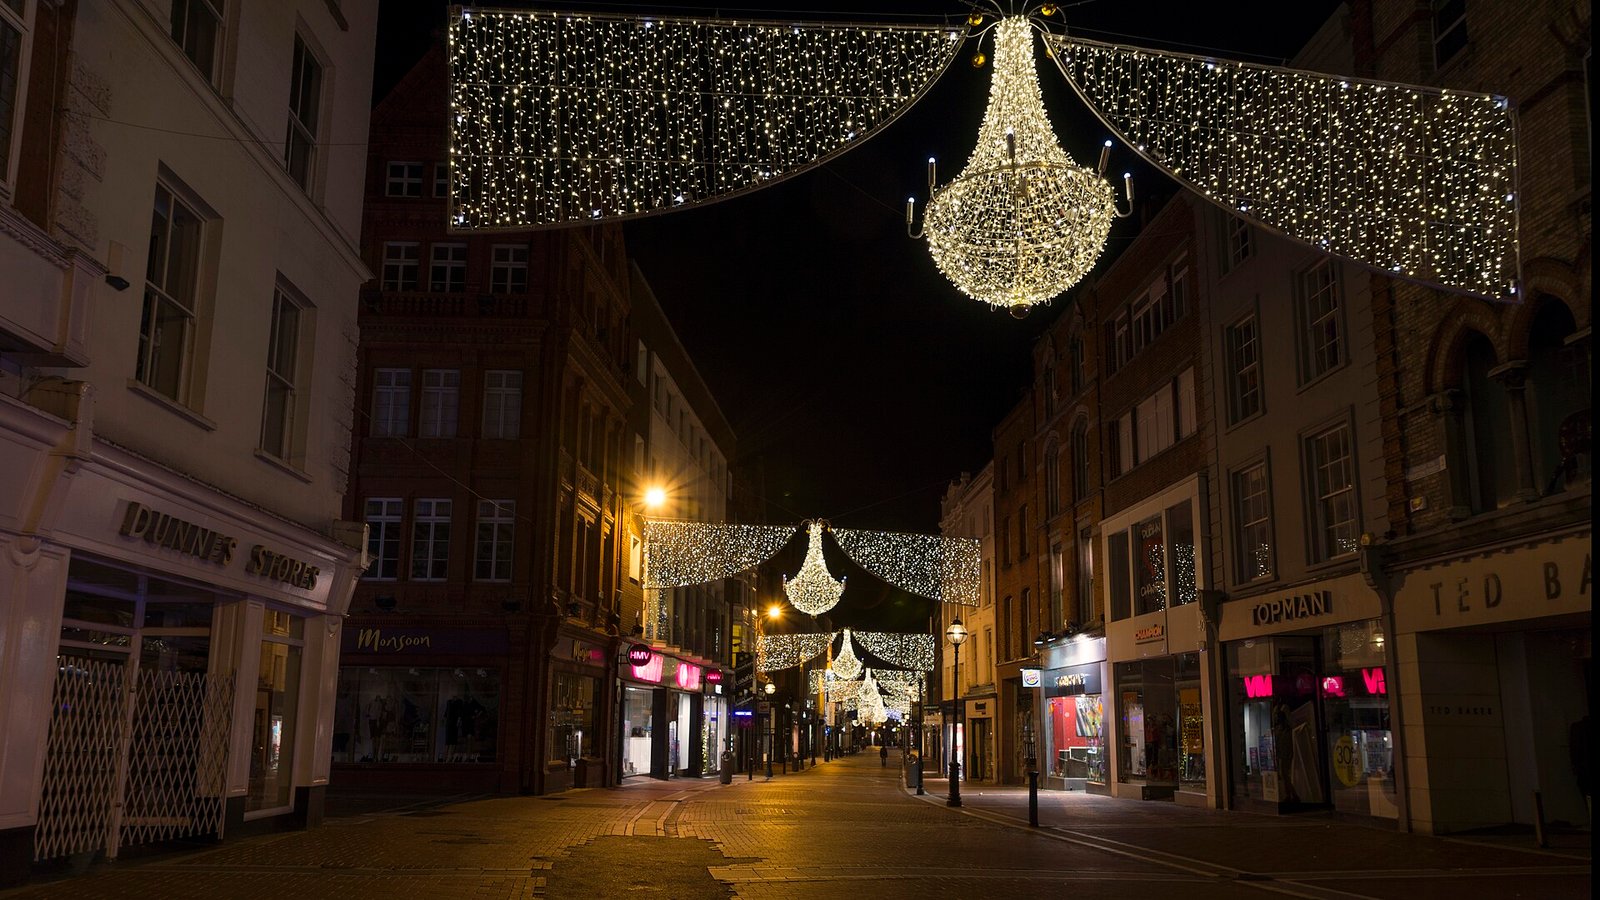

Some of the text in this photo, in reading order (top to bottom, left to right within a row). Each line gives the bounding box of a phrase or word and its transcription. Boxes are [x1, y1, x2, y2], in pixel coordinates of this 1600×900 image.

[120, 500, 319, 591] DUNNES STORES
[1248, 590, 1332, 626] TOPMAN
[1430, 573, 1502, 615] TED
[630, 651, 650, 660] HMV
